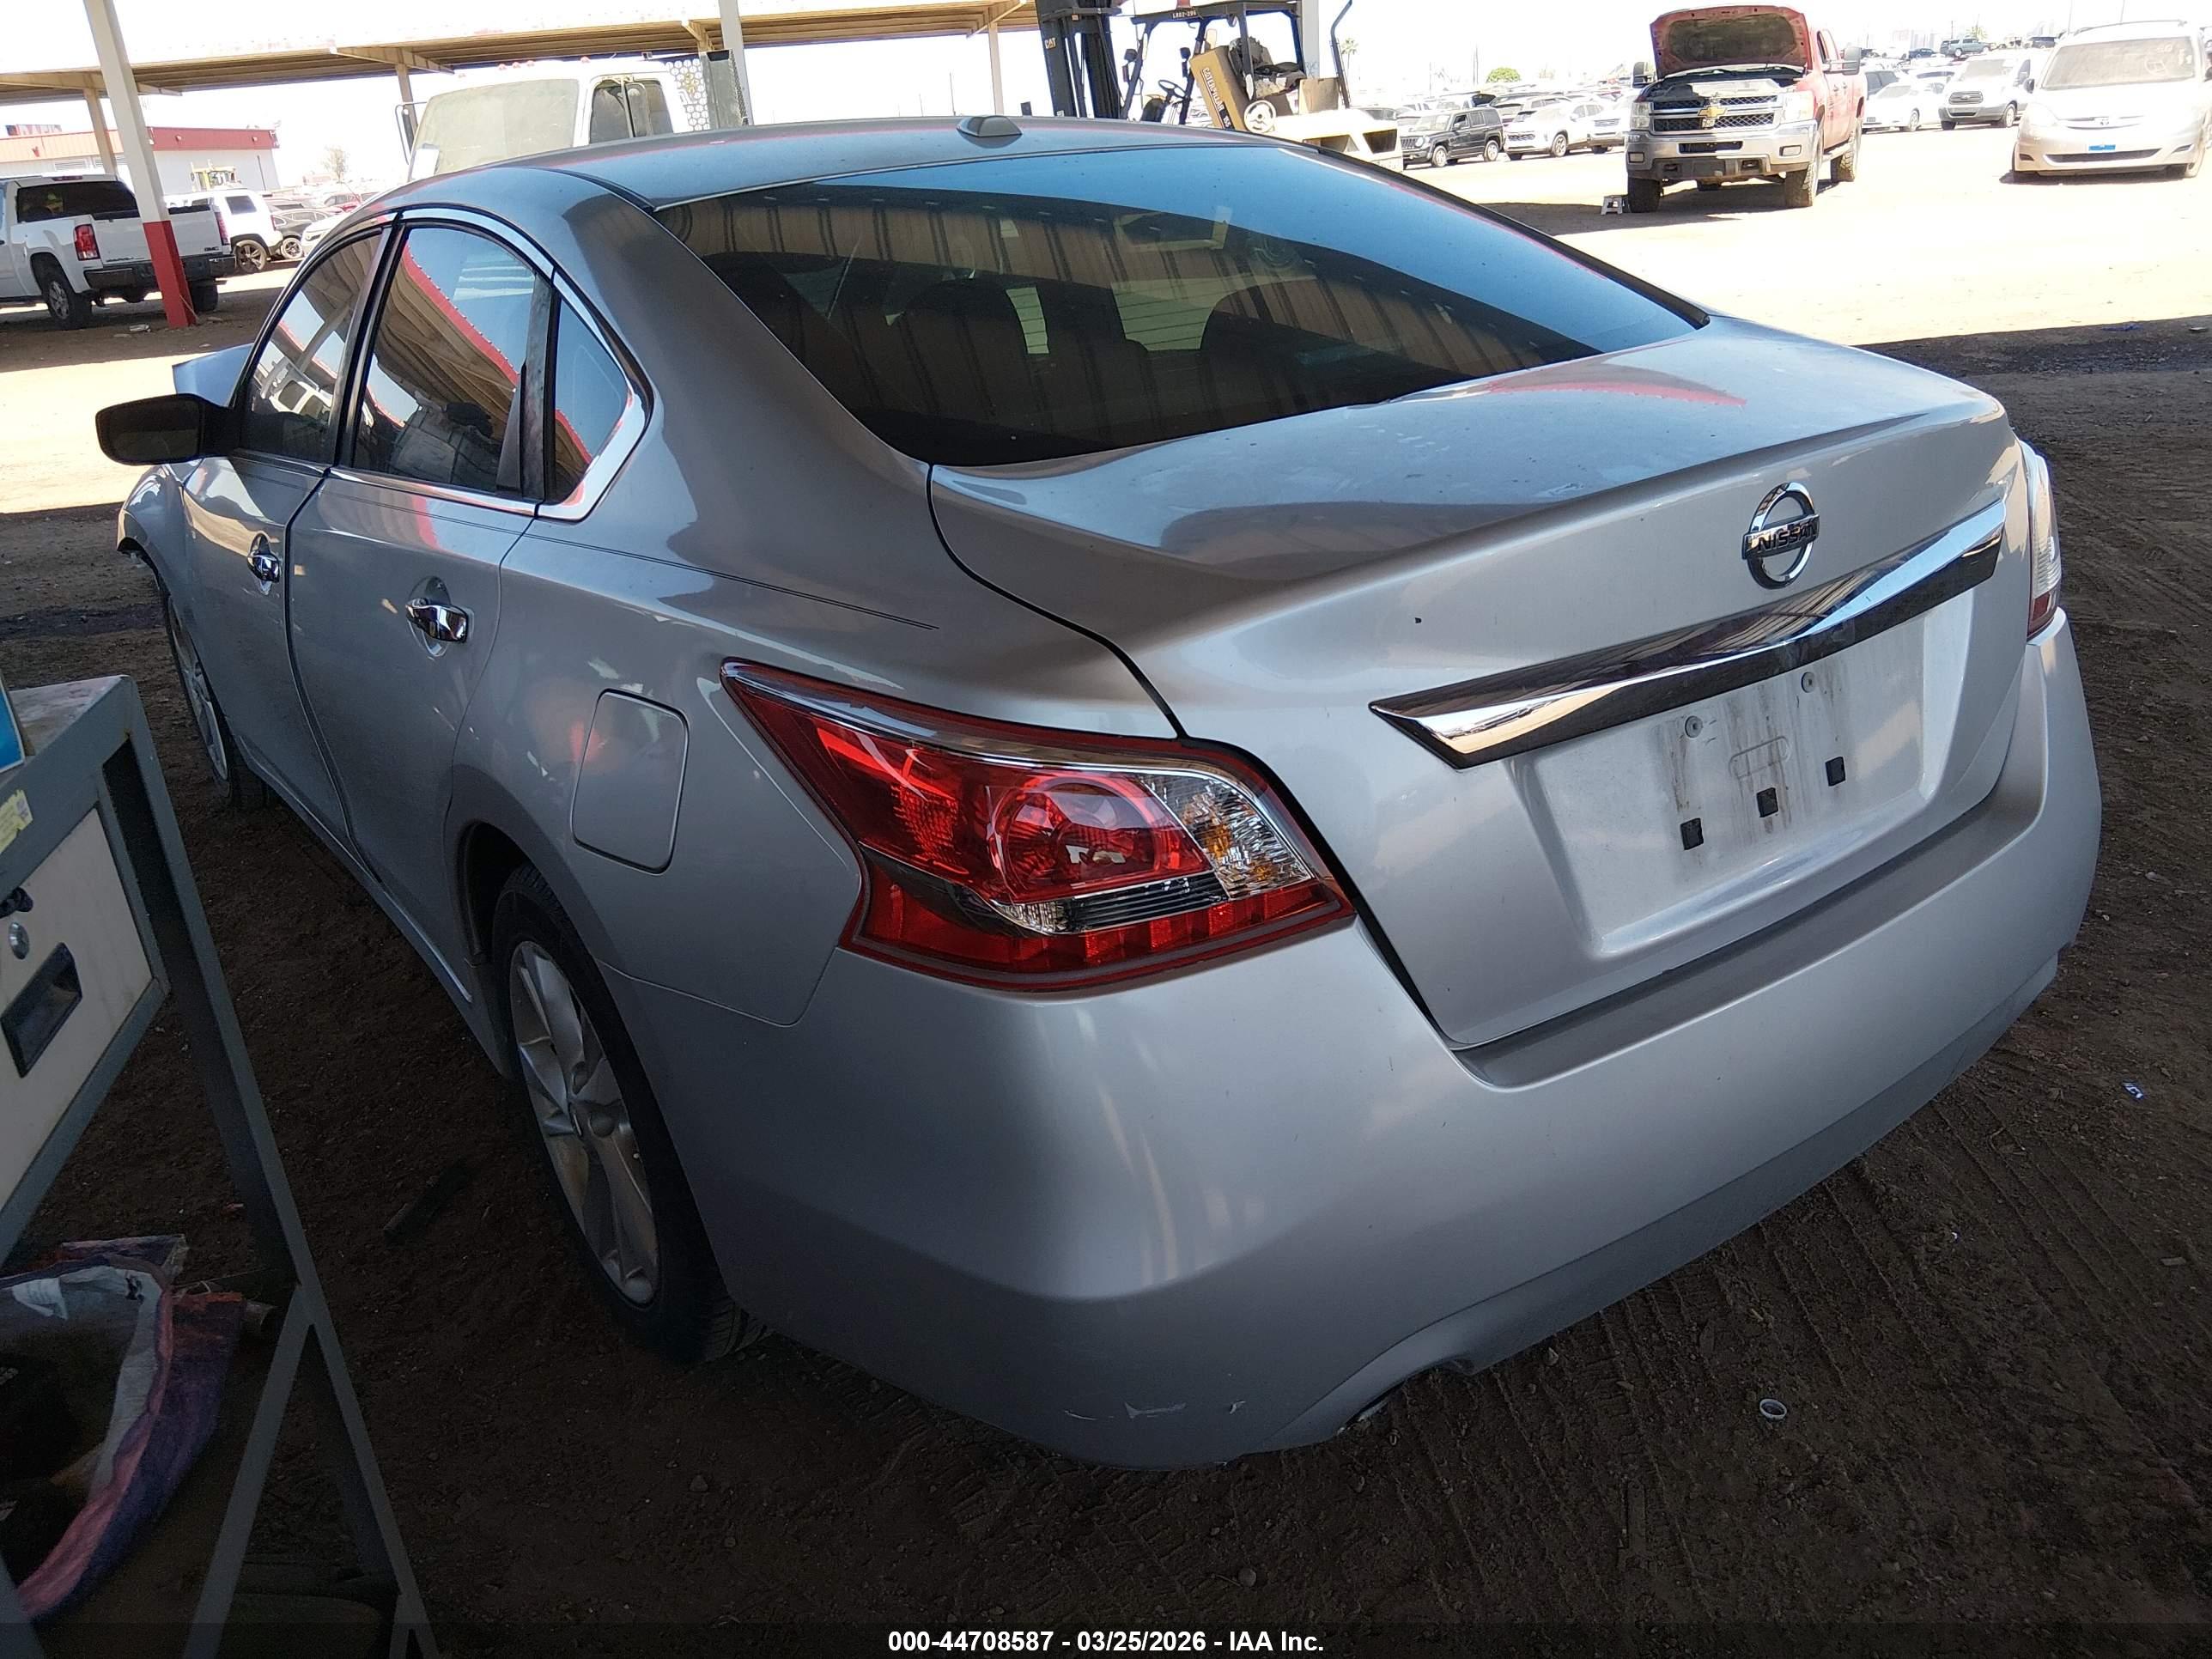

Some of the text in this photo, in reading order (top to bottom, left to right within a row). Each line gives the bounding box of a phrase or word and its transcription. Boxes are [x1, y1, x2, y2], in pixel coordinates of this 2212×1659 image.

[1044, 38, 1056, 49] CAT
[1202, 67, 1225, 112] CATERPILLAR
[1757, 518, 1816, 551] NISSAN
